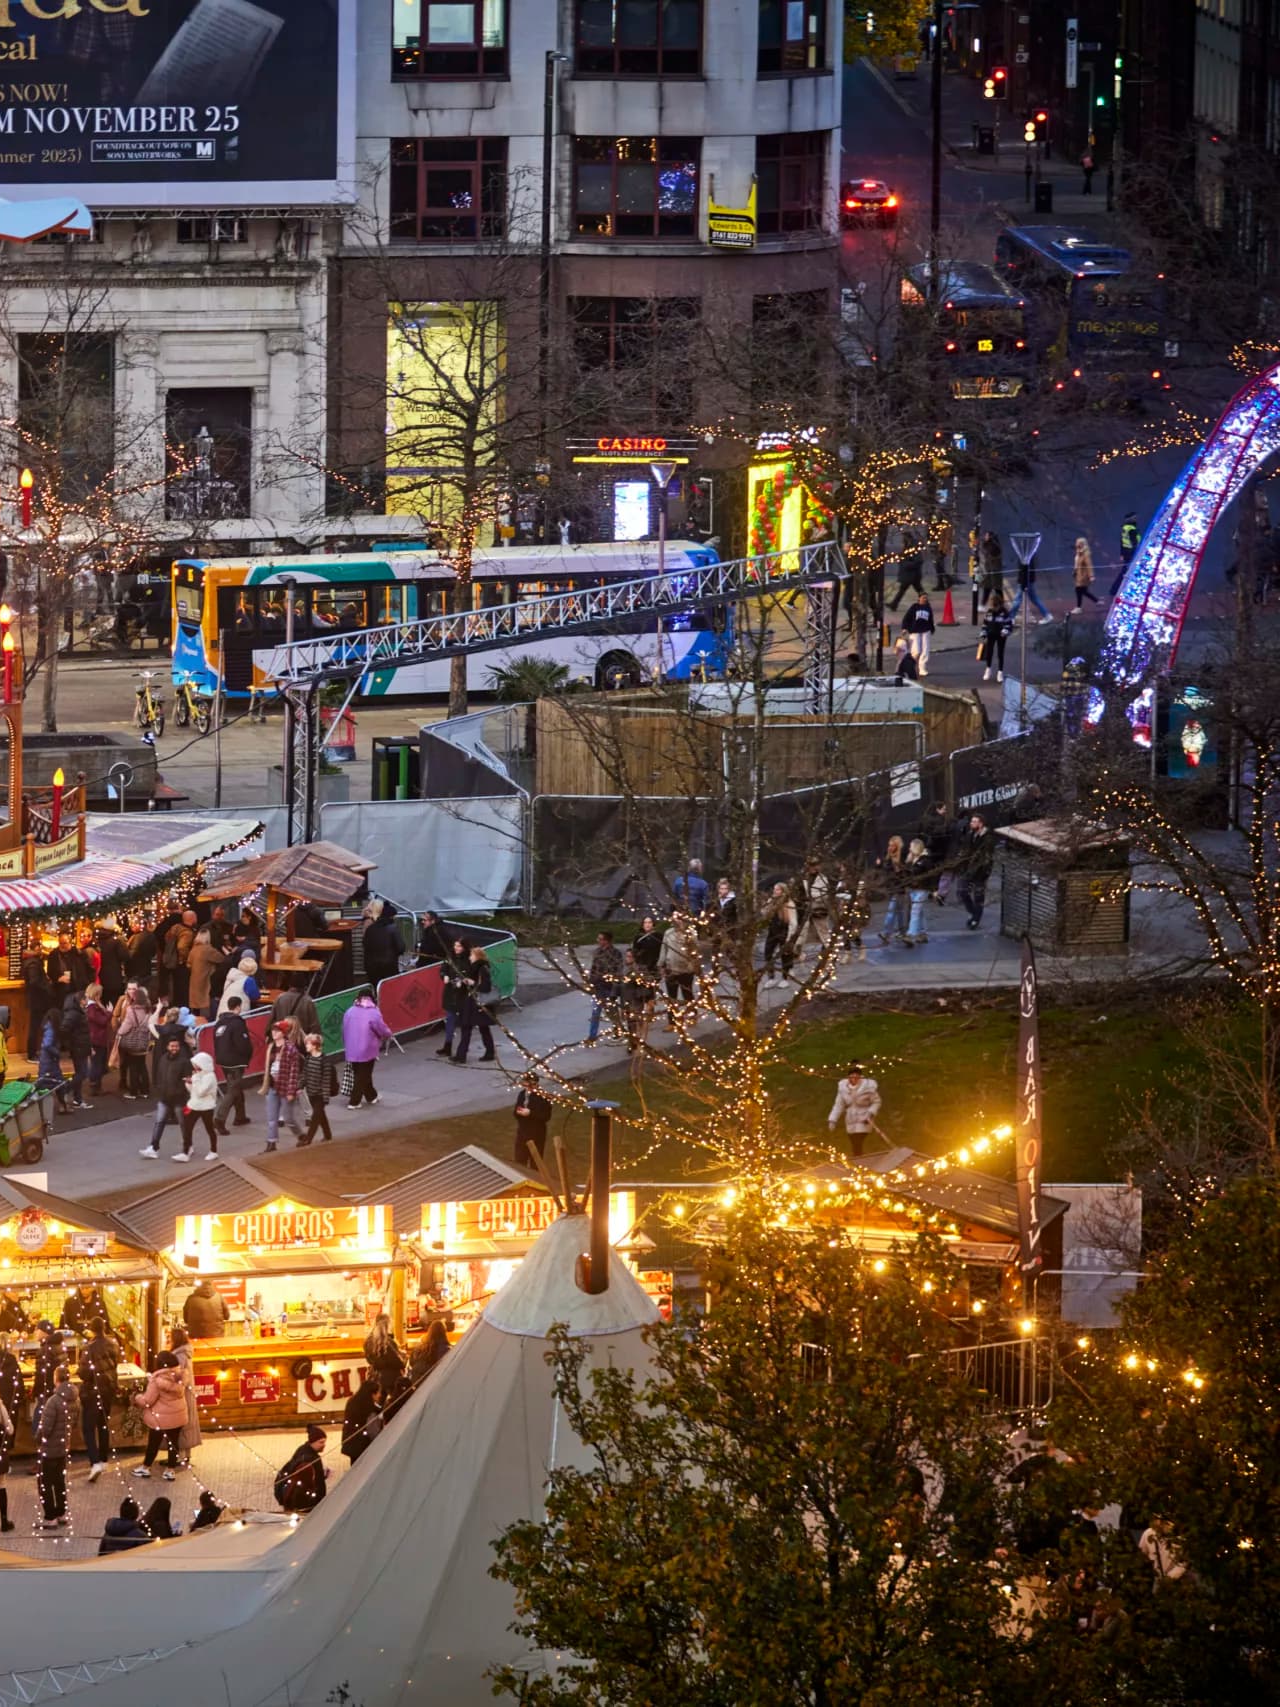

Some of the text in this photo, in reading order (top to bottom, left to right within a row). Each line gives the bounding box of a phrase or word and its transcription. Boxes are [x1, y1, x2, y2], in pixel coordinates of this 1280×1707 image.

[9, 82, 68, 102] NOW!
[23, 104, 199, 134] NOVEMBER
[203, 104, 241, 132] 25
[40, 147, 83, 164] 2023)
[421, 413, 457, 424] HOUSE
[597, 437, 667, 451] CASINO
[233, 1210, 335, 1245] CHURROS
